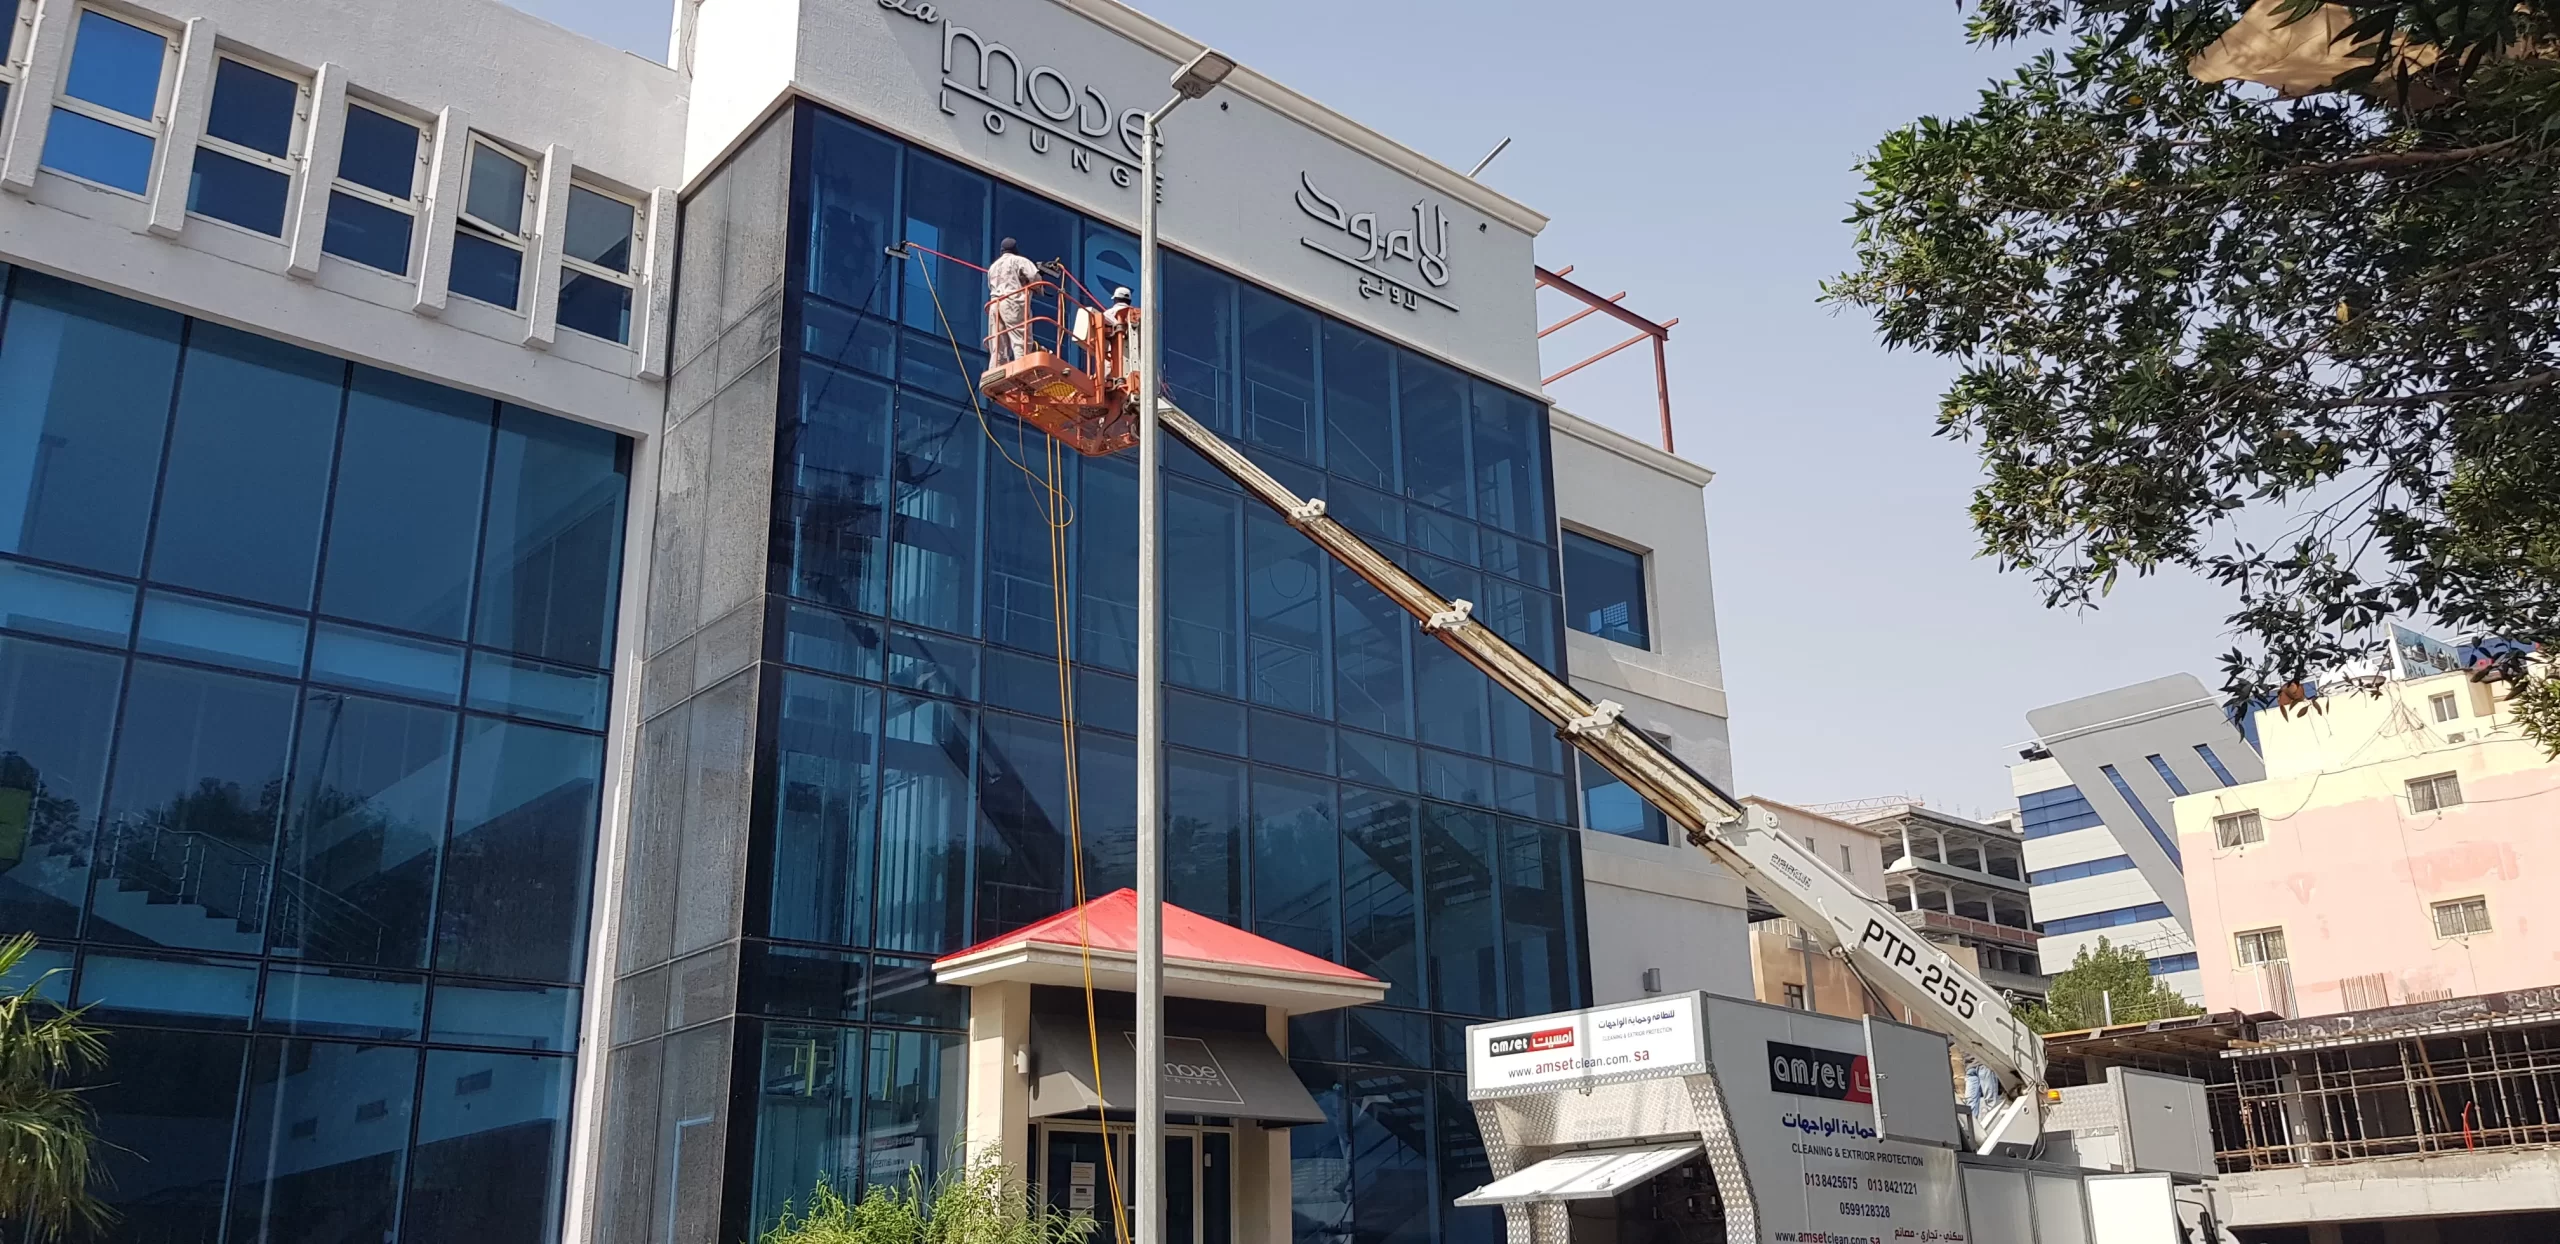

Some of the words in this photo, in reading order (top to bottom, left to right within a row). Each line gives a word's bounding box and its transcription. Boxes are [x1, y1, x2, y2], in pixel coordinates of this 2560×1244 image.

[1862, 918, 1978, 1019] PTP-255
[1782, 1112, 1841, 1138] الواجهات
[1792, 1143, 1833, 1158] CLEANING
[1842, 1149, 1876, 1162] EXTRIOR
[1877, 1151, 1924, 1167] PROTECTION
[1840, 1202, 1891, 1218] 0599128328
